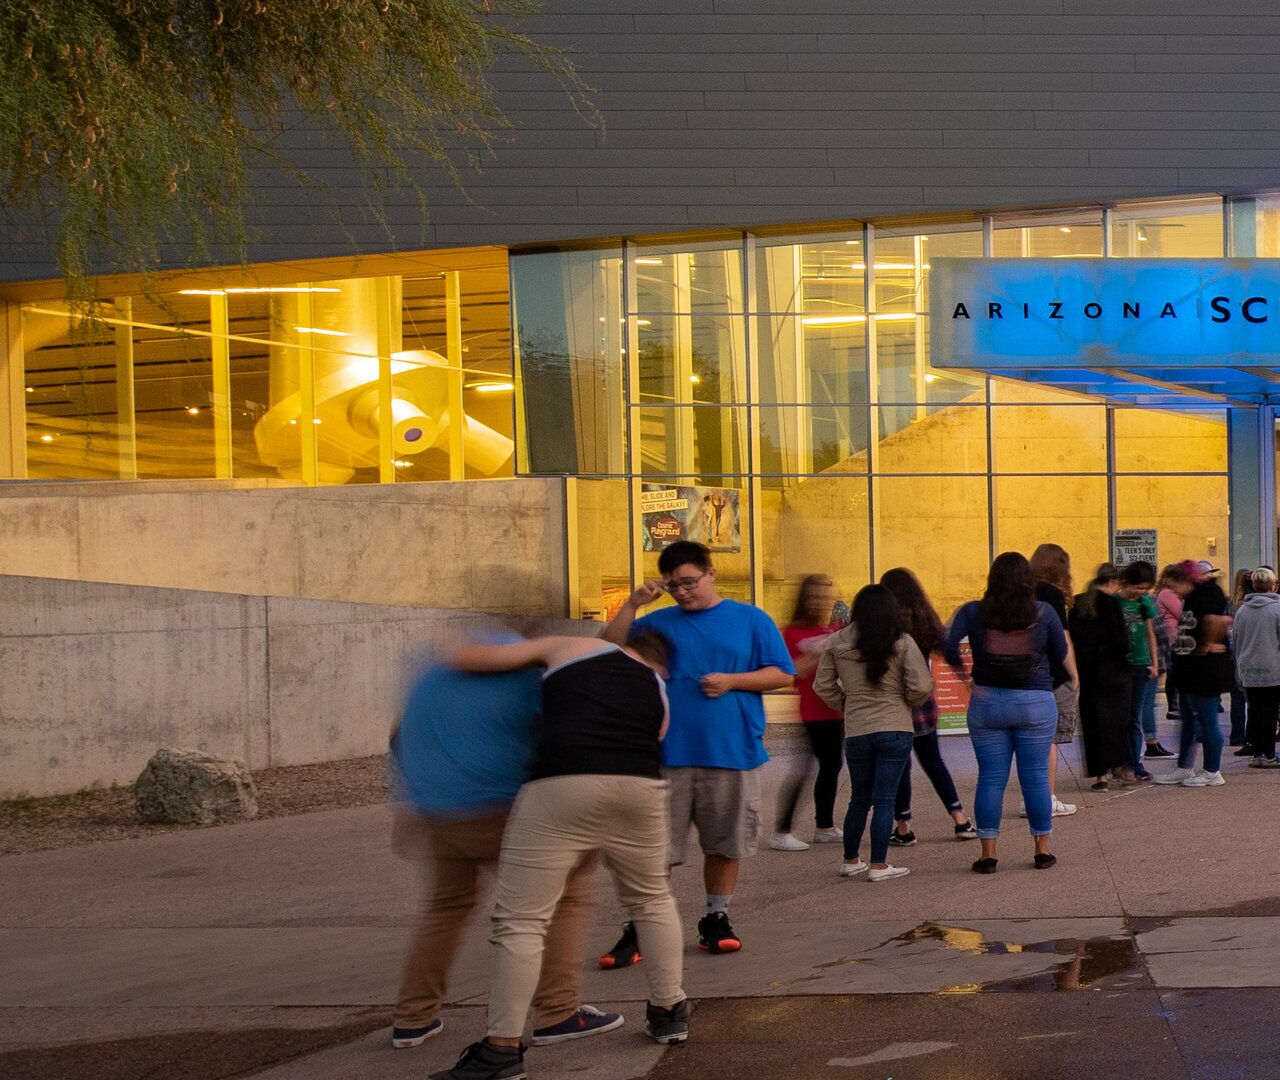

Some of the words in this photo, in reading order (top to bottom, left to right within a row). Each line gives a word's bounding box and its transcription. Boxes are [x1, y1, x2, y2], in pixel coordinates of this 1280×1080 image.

[952, 302, 1178, 319] ARIZONA
[650, 492, 664, 500] SLIDE
[664, 491, 676, 499] AND
[667, 501, 687, 509] GALAXY
[650, 526, 680, 537] Playground
